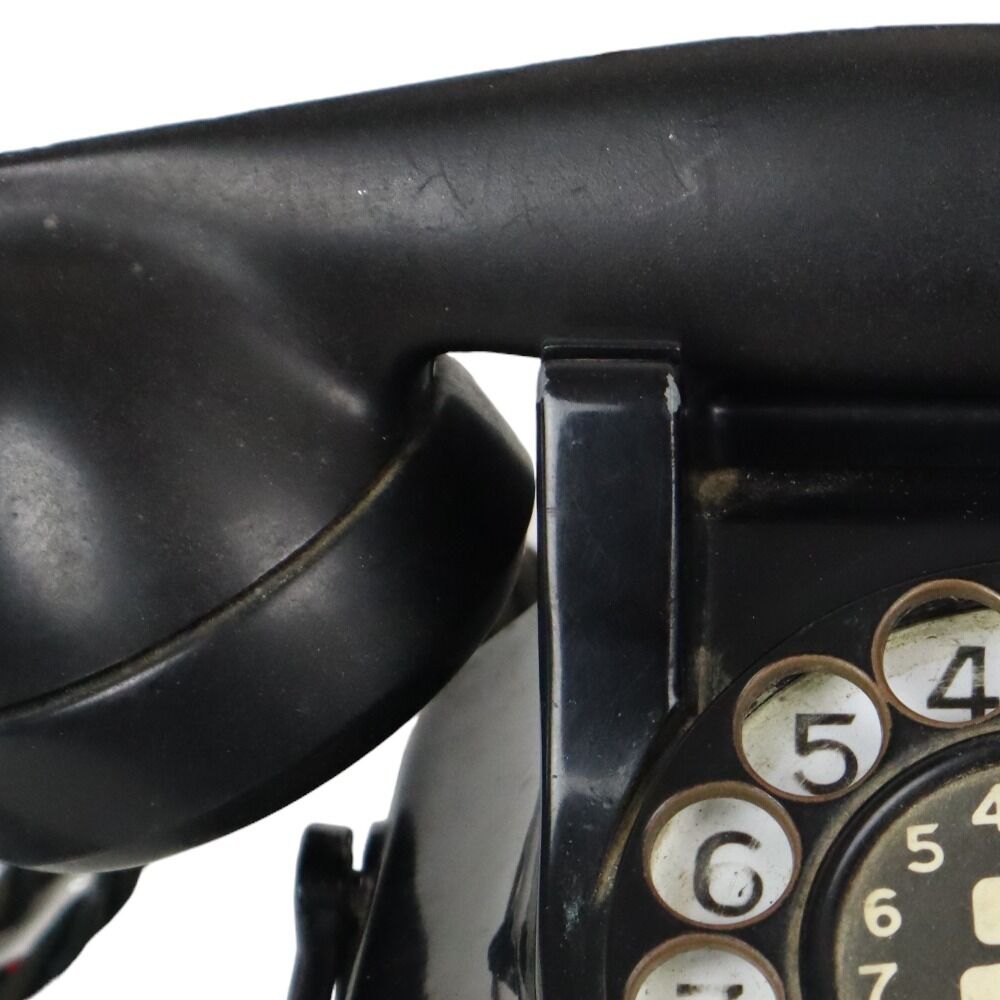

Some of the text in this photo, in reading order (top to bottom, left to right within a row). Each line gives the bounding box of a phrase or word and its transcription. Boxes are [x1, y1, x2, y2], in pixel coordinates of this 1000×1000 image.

[927, 645, 1000, 720] 4
[794, 712, 859, 795] 5
[693, 830, 764, 918] 6
[905, 822, 945, 874] 5
[862, 887, 903, 939] 6
